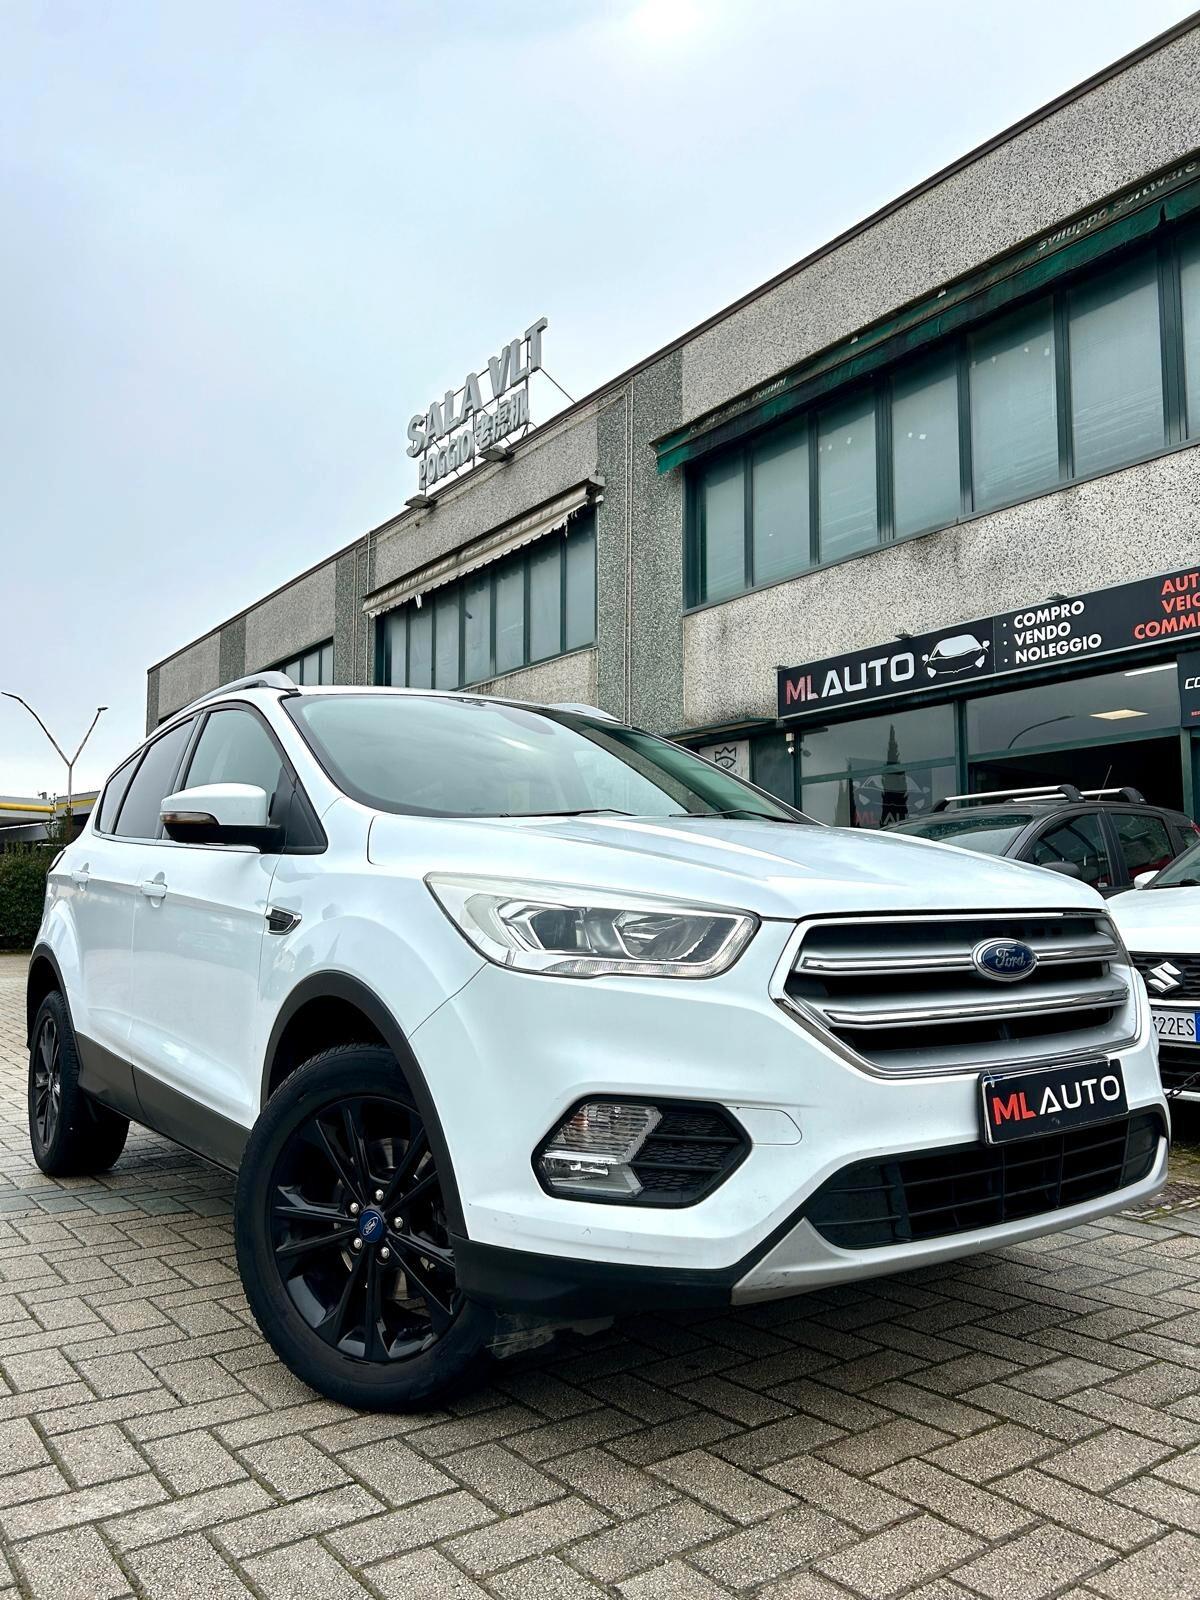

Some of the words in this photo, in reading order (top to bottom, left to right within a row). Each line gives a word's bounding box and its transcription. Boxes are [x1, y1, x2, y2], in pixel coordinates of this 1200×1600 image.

[406, 373, 483, 458] SALA
[488, 316, 548, 399] VLT
[418, 429, 475, 491] POGGIO
[1013, 600, 1085, 629] COMPRO
[1134, 611, 1200, 640] COMM
[1014, 621, 1071, 646] VENDO
[1015, 633, 1102, 664] NOLEGGIO
[995, 947, 1026, 969] Ford
